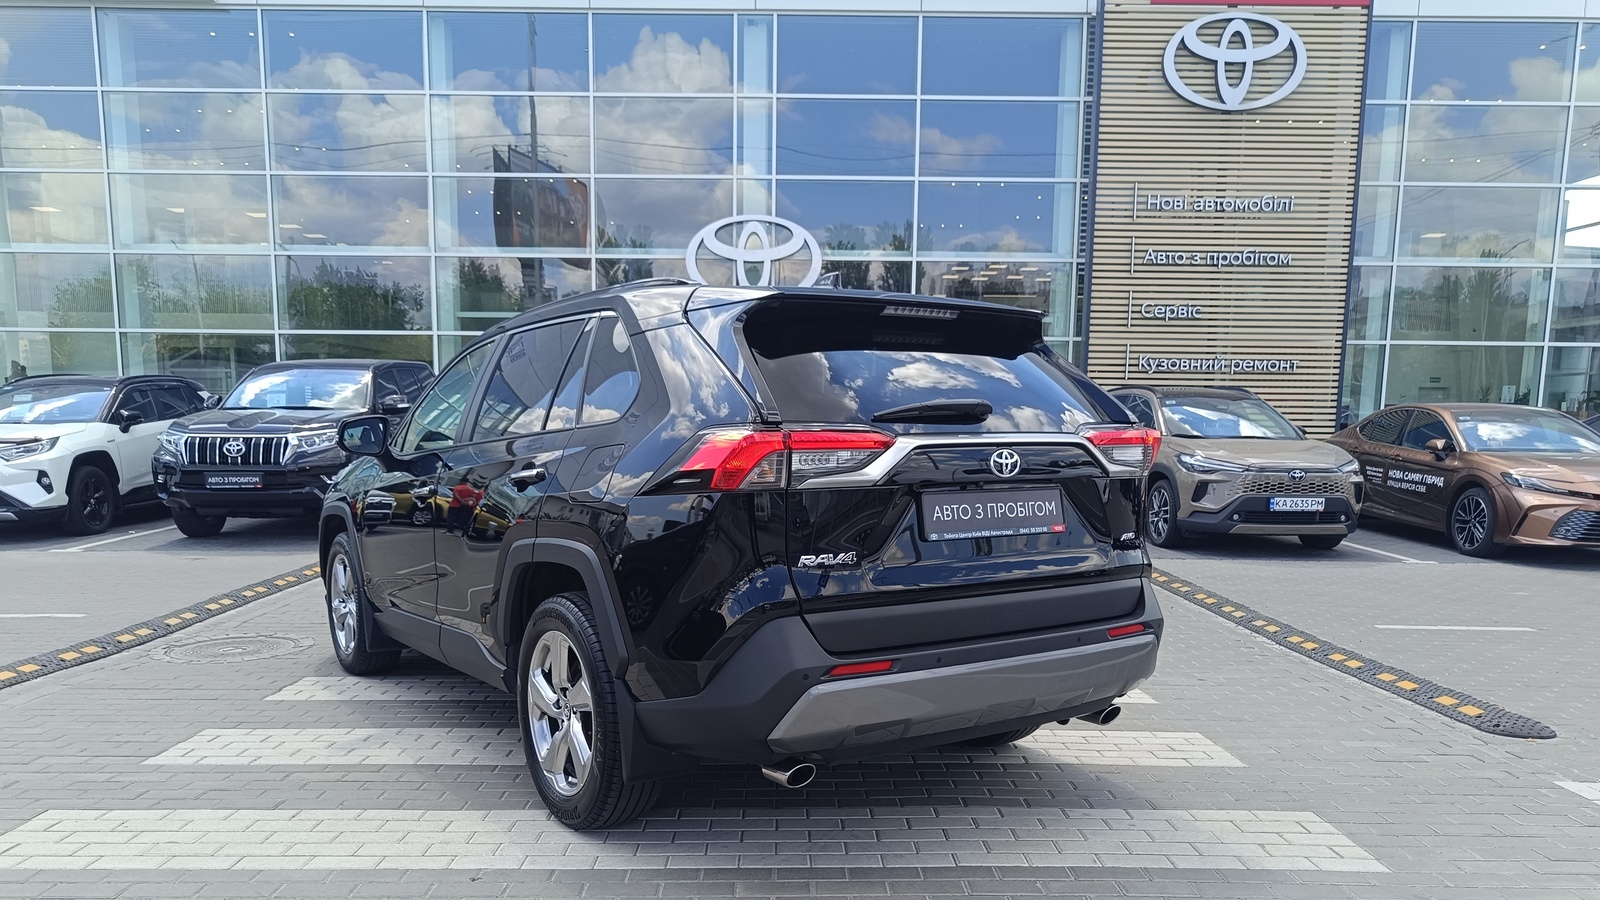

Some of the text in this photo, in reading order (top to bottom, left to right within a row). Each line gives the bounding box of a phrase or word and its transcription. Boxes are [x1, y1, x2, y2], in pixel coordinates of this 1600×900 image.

[1146, 193, 1295, 212] Нові автомобілі
[1143, 248, 1292, 269] Авто з пробігом
[1140, 303, 1203, 322] Сервіс
[1138, 353, 1300, 375] Кузовний ремонт
[1388, 469, 1403, 479] НОВА
[1403, 471, 1423, 482] CAMRY
[1422, 474, 1444, 488] ГІБРИД
[933, 501, 1057, 521] АВТО З ПРОБІГОМ
[798, 552, 857, 567] RAV4
